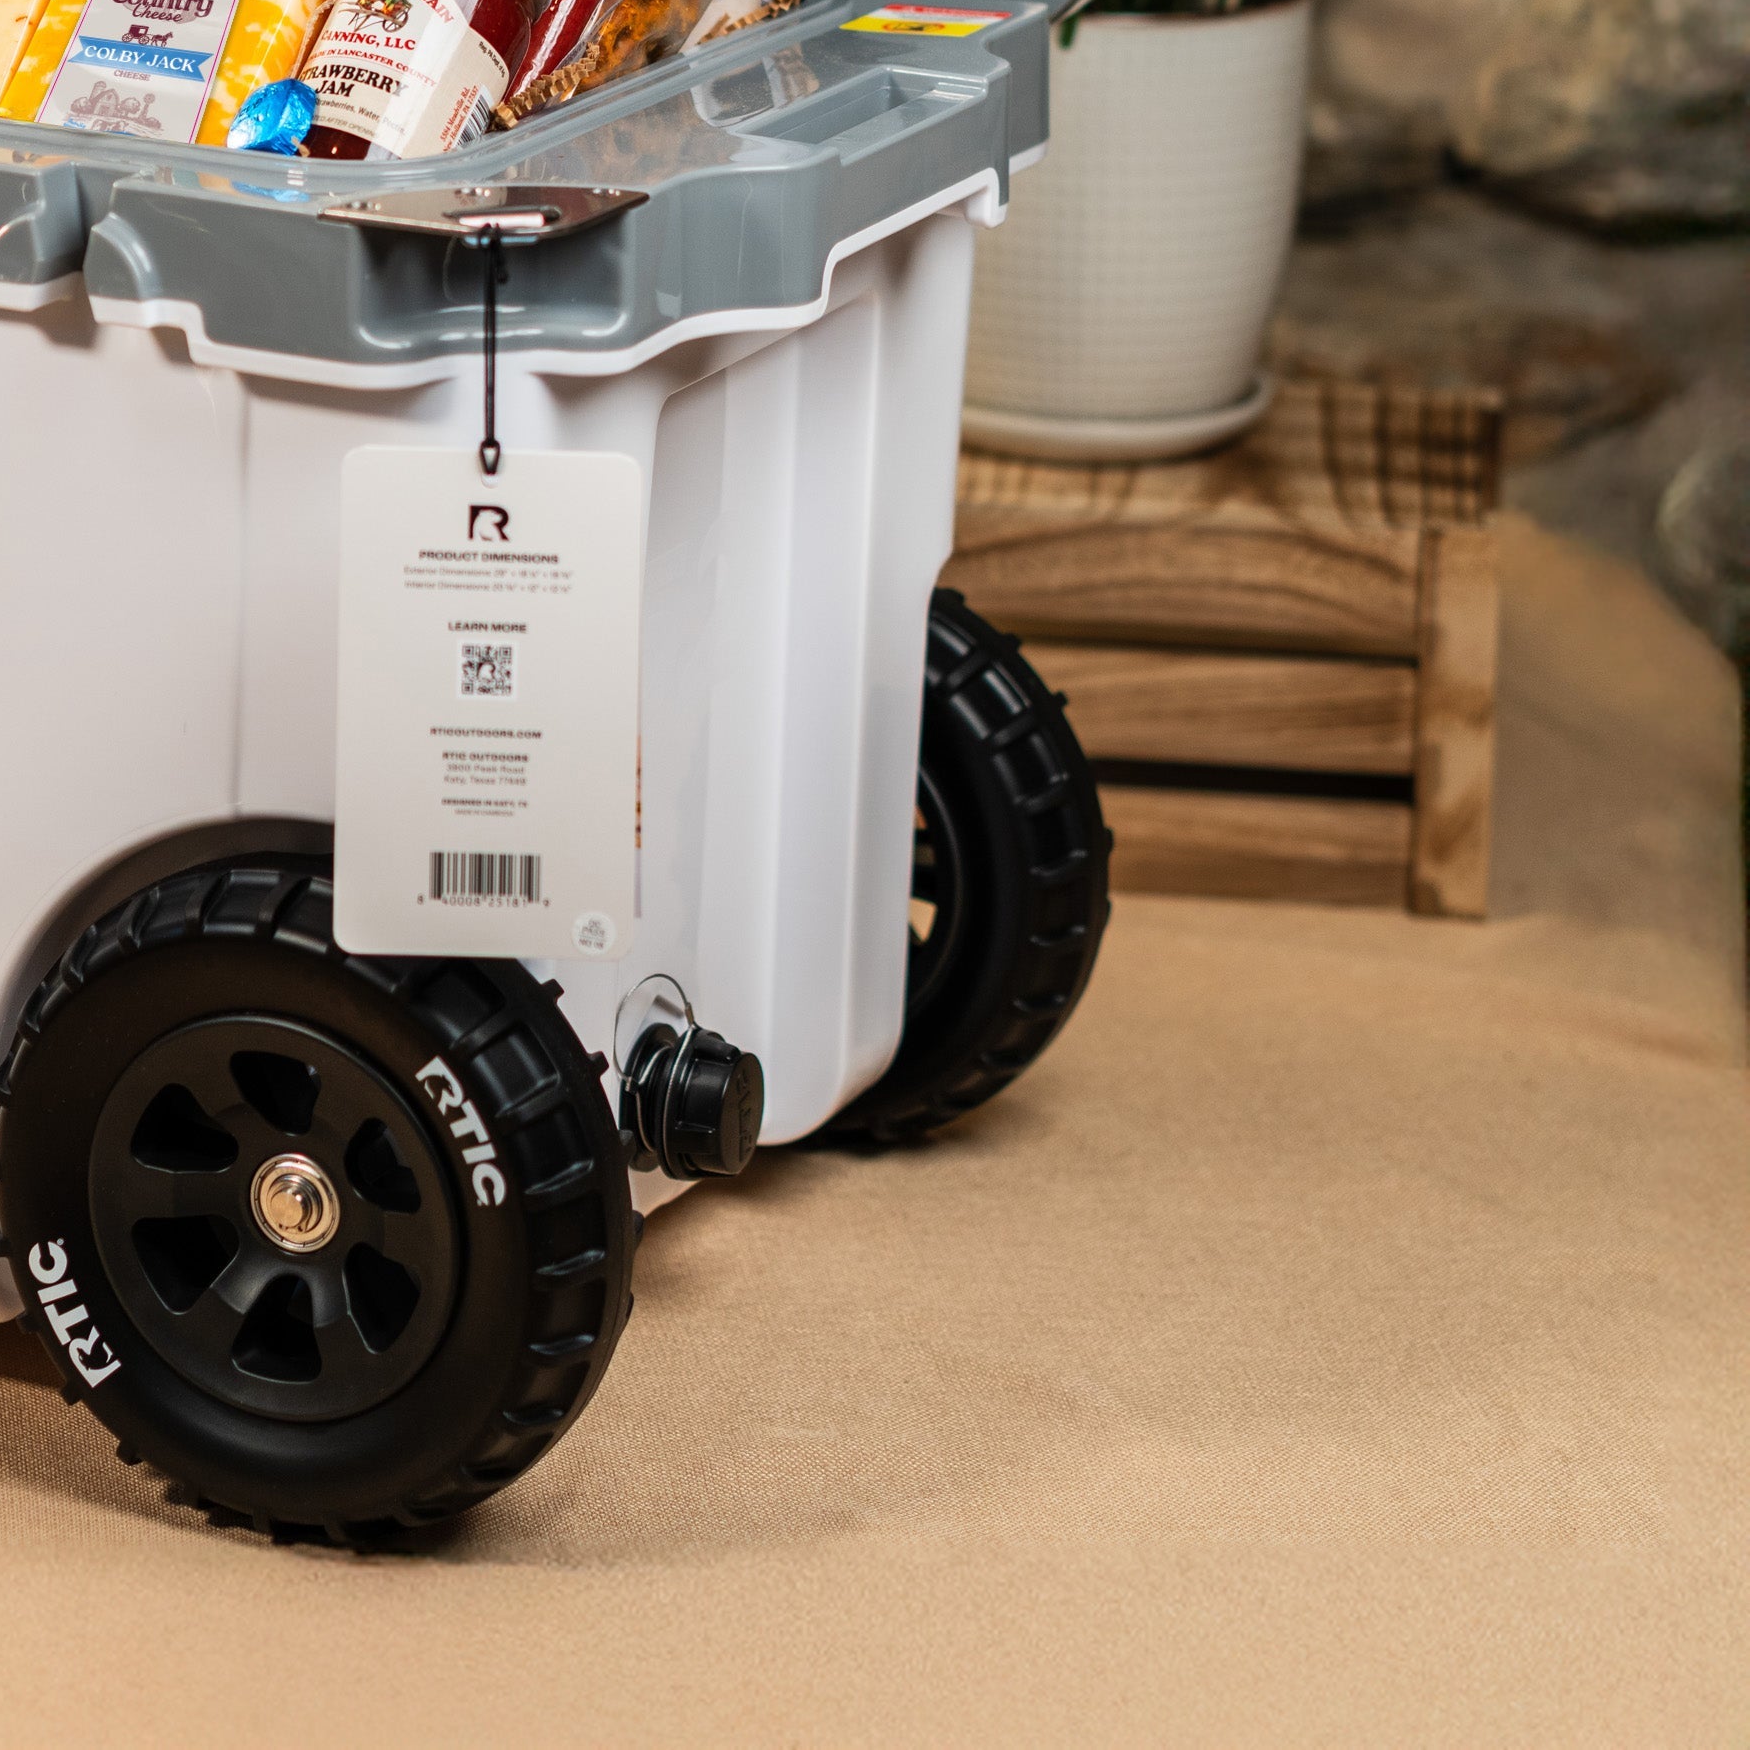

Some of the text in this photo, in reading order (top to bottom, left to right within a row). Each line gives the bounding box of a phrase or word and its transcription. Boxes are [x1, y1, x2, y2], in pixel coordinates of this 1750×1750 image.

[132, 2, 183, 23] Cheese
[384, 36, 417, 51] LLC
[84, 45, 197, 73] COLBY JACK
[337, 49, 394, 67] LANCASTER
[113, 69, 151, 82] CHEESE
[315, 80, 355, 97] JAM
[419, 549, 560, 565] PRODUCT DIMENSIONS
[448, 621, 527, 634] LEARN MORE
[429, 727, 542, 740] RTICOUTDOORS.COM
[441, 751, 529, 763] RTIC OUTDOORS
[417, 892, 424, 905] 8
[414, 1055, 507, 1207] RTIC
[28, 1240, 122, 1388] RTIC
